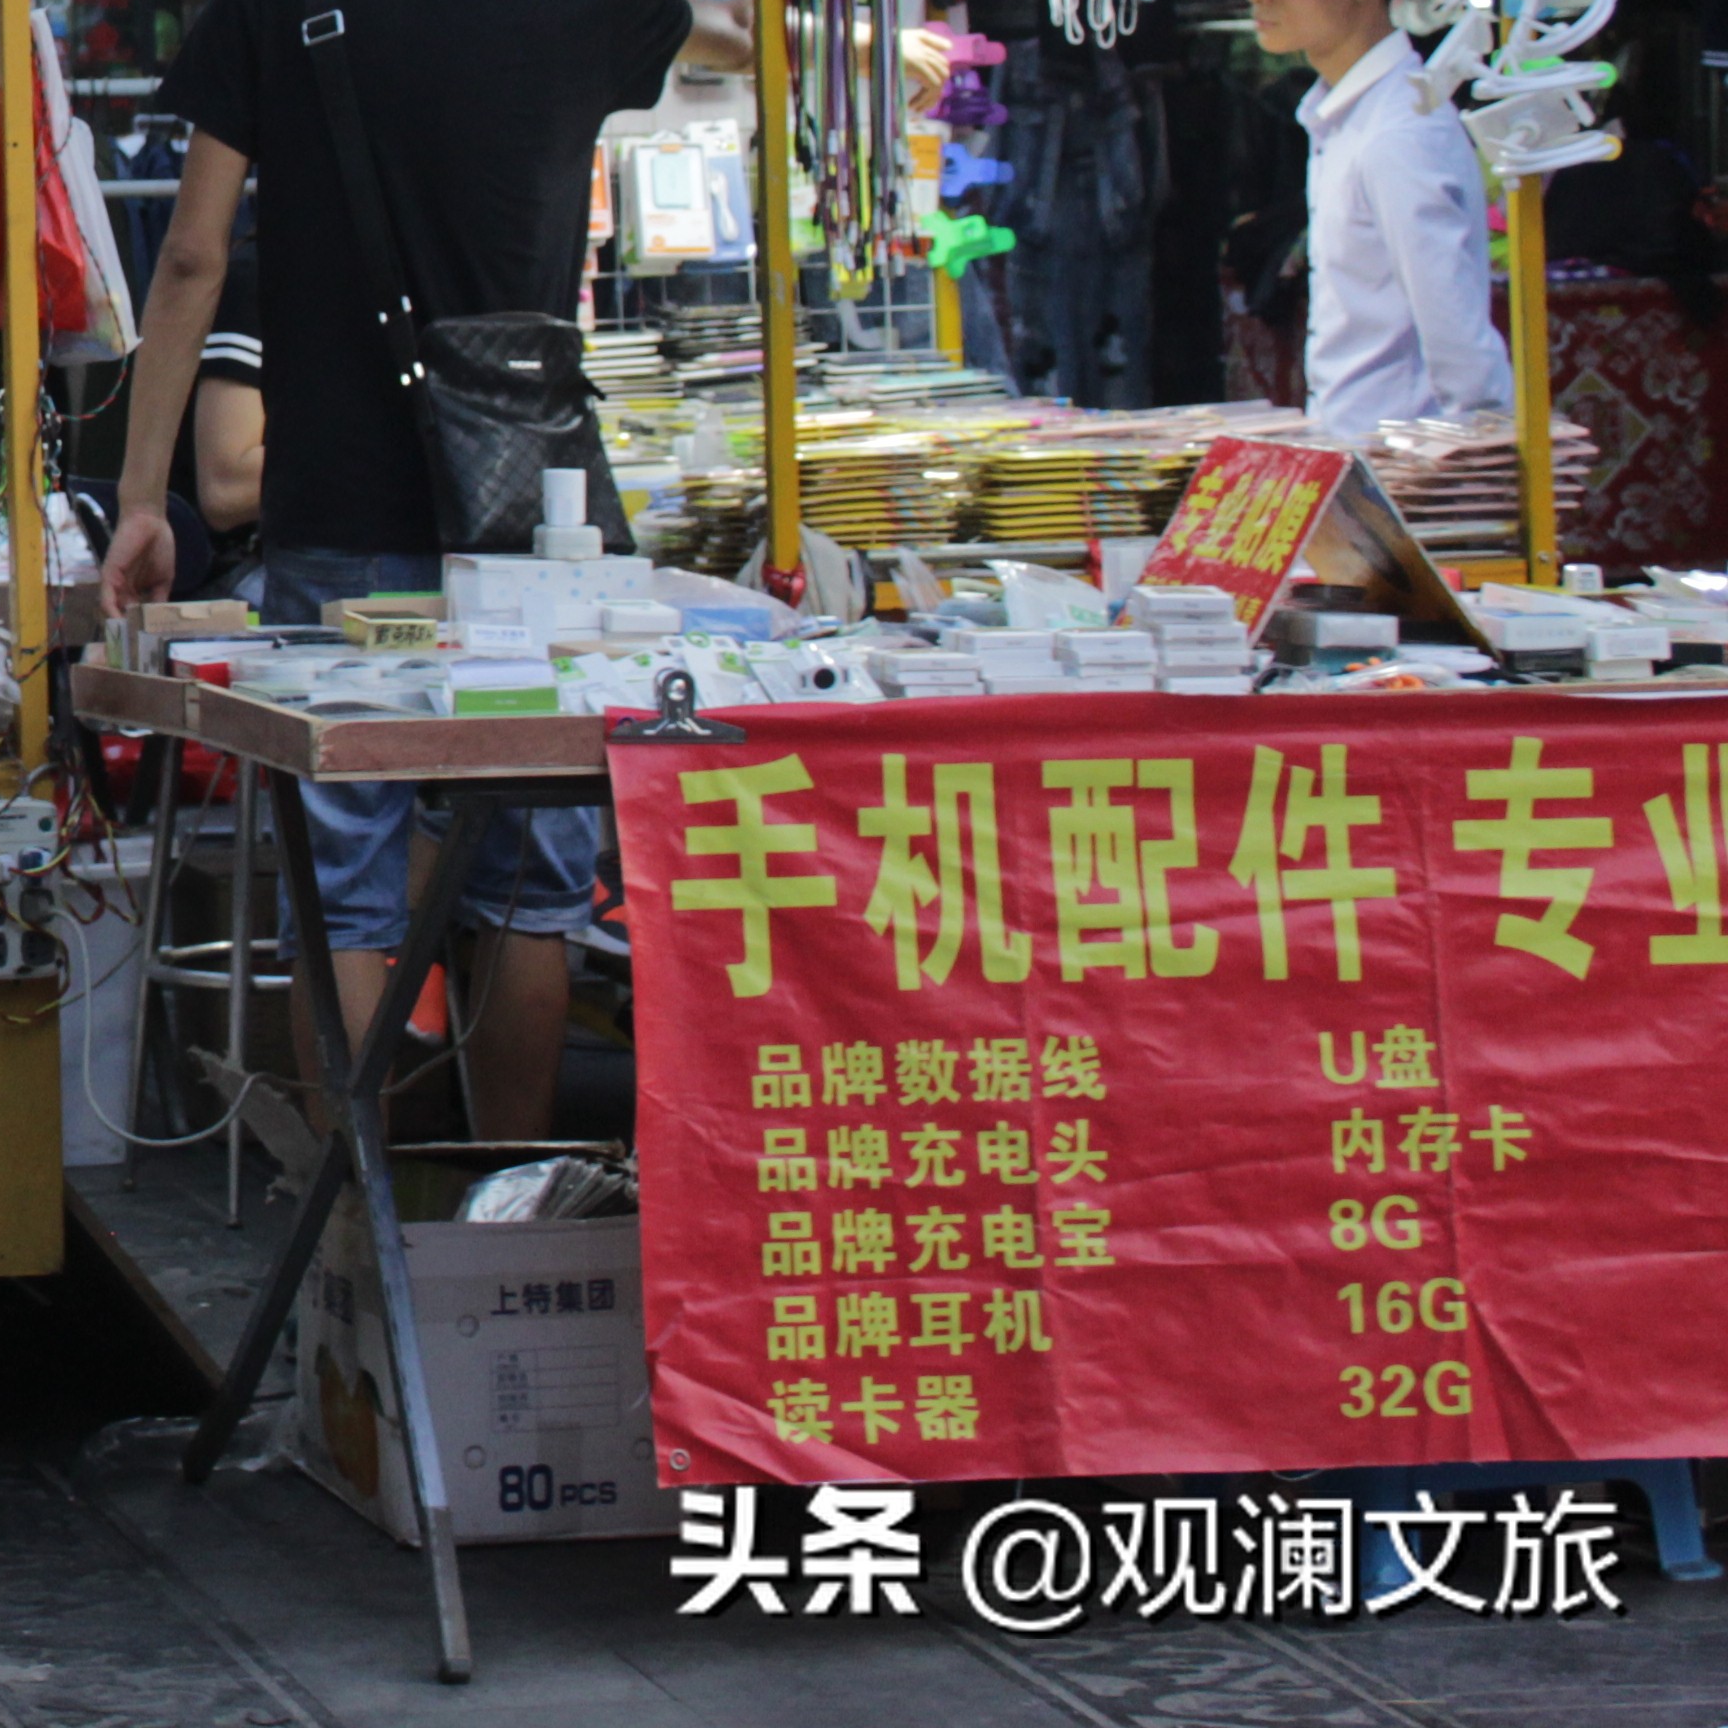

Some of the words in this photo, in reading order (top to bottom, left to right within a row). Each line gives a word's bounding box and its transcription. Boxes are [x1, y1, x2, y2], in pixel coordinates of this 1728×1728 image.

[671, 743, 1397, 998] 手机配件
[751, 1035, 1107, 1108] 品牌数据线
[1319, 1024, 1440, 1089] U盘
[758, 1119, 1108, 1191] 品牌充电头
[1331, 1104, 1532, 1173] 内存卡
[762, 1202, 1115, 1276] 品牌充电宝
[1329, 1194, 1421, 1251] 8G
[767, 1288, 1053, 1360] 品牌耳机
[1338, 1277, 1468, 1335] 16G
[767, 1374, 981, 1445] 读卡器
[1340, 1360, 1473, 1419] 32G
[500, 1464, 554, 1513] 80
[560, 1481, 618, 1509] PCS
